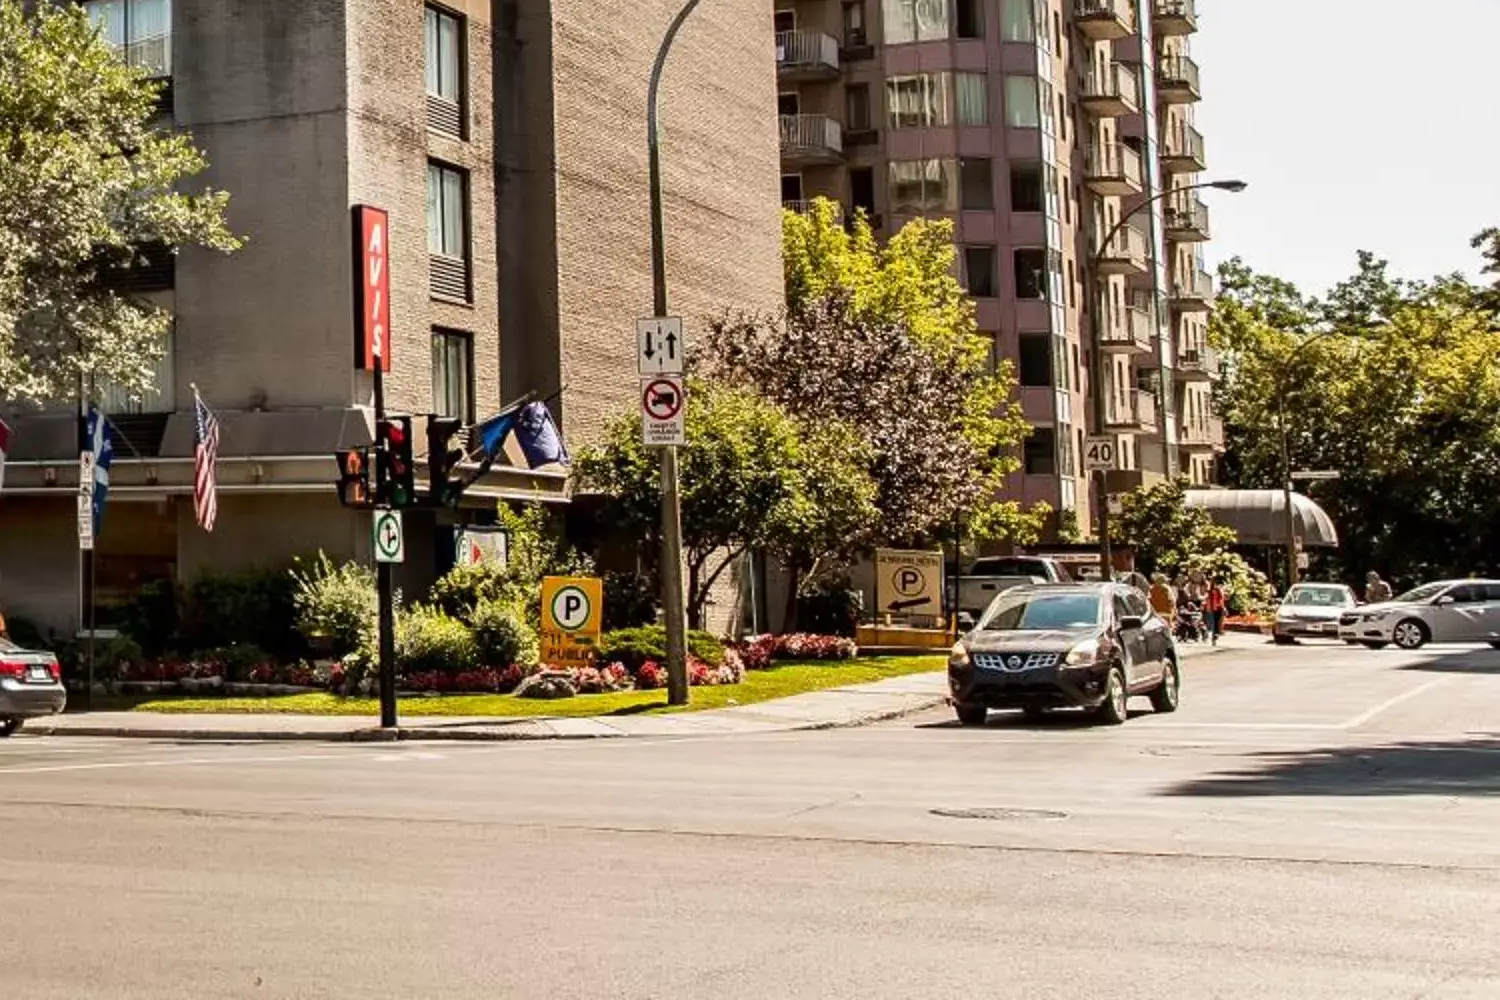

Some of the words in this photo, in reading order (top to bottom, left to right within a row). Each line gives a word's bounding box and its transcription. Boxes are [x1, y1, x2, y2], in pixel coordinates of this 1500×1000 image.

[368, 223, 383, 357] AVIS
[1087, 444, 1111, 462] 40
[902, 571, 919, 592] P
[565, 595, 581, 620] P
